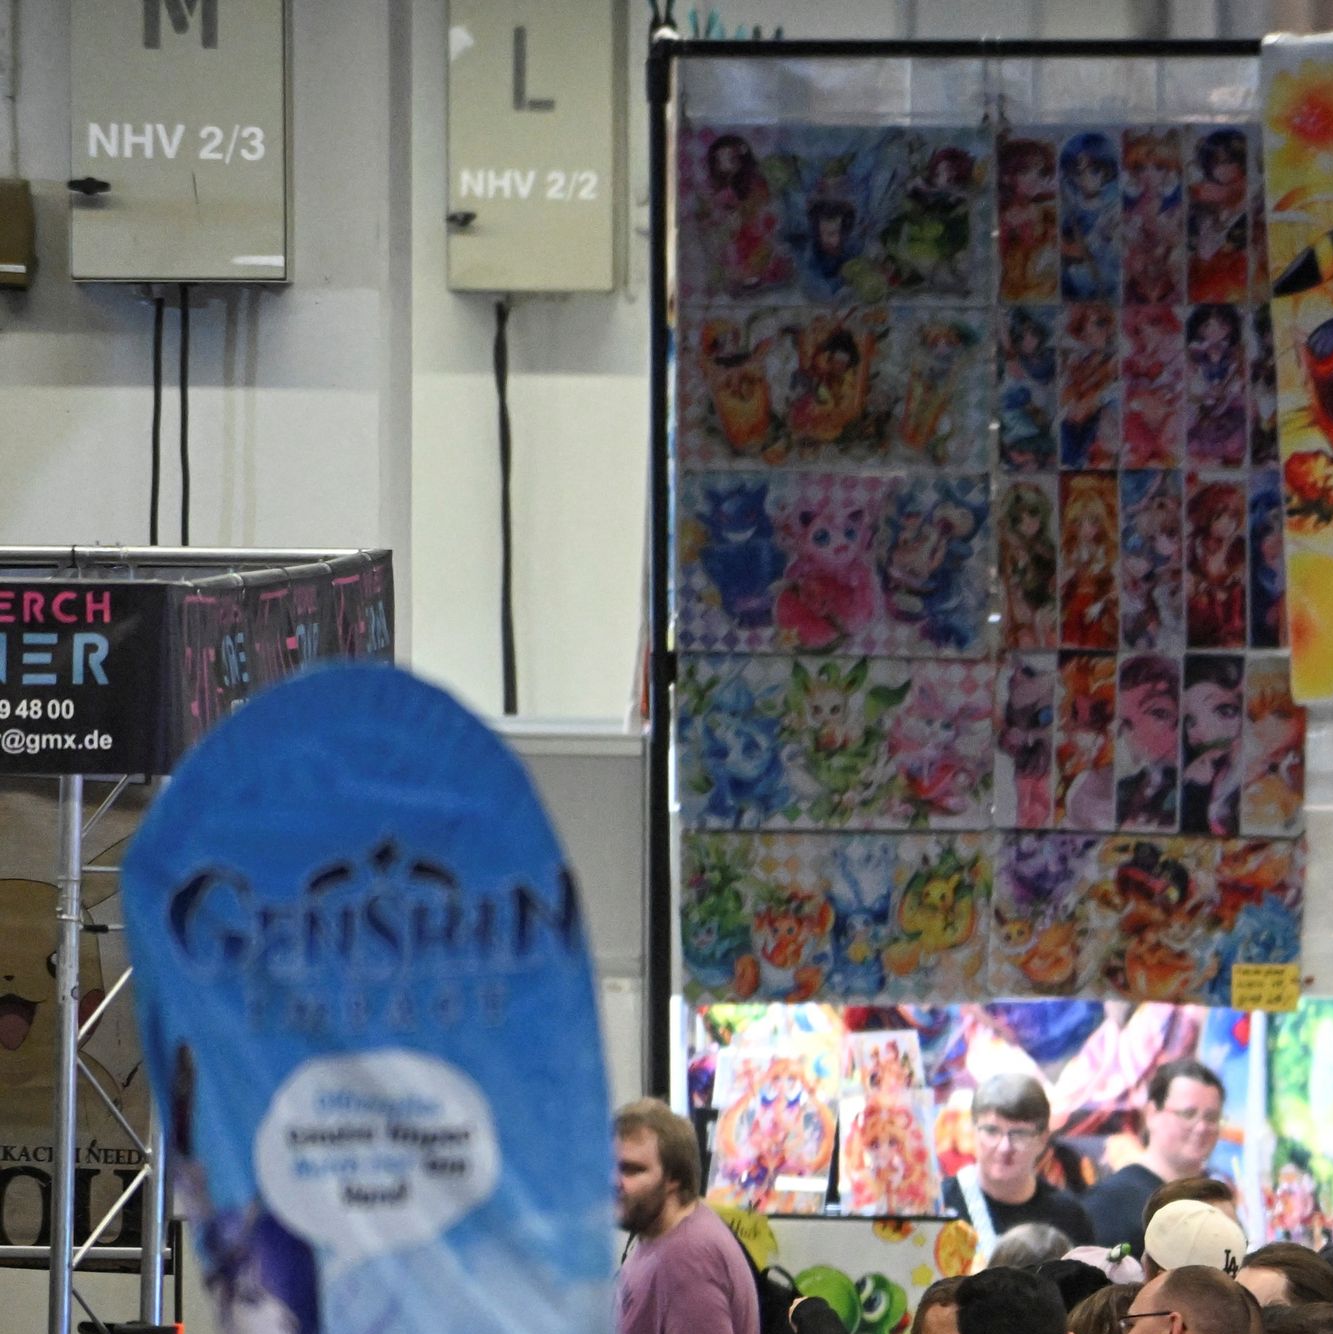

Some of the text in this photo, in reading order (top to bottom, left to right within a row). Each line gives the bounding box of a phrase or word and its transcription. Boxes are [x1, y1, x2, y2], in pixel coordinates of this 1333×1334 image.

[513, 25, 555, 112] L
[88, 122, 266, 164] NHV 2/3
[460, 169, 599, 200] NHV 2/2
[15, 699, 43, 719] 48
[47, 699, 75, 719] 00
[87, 1148, 143, 1165] NEED
